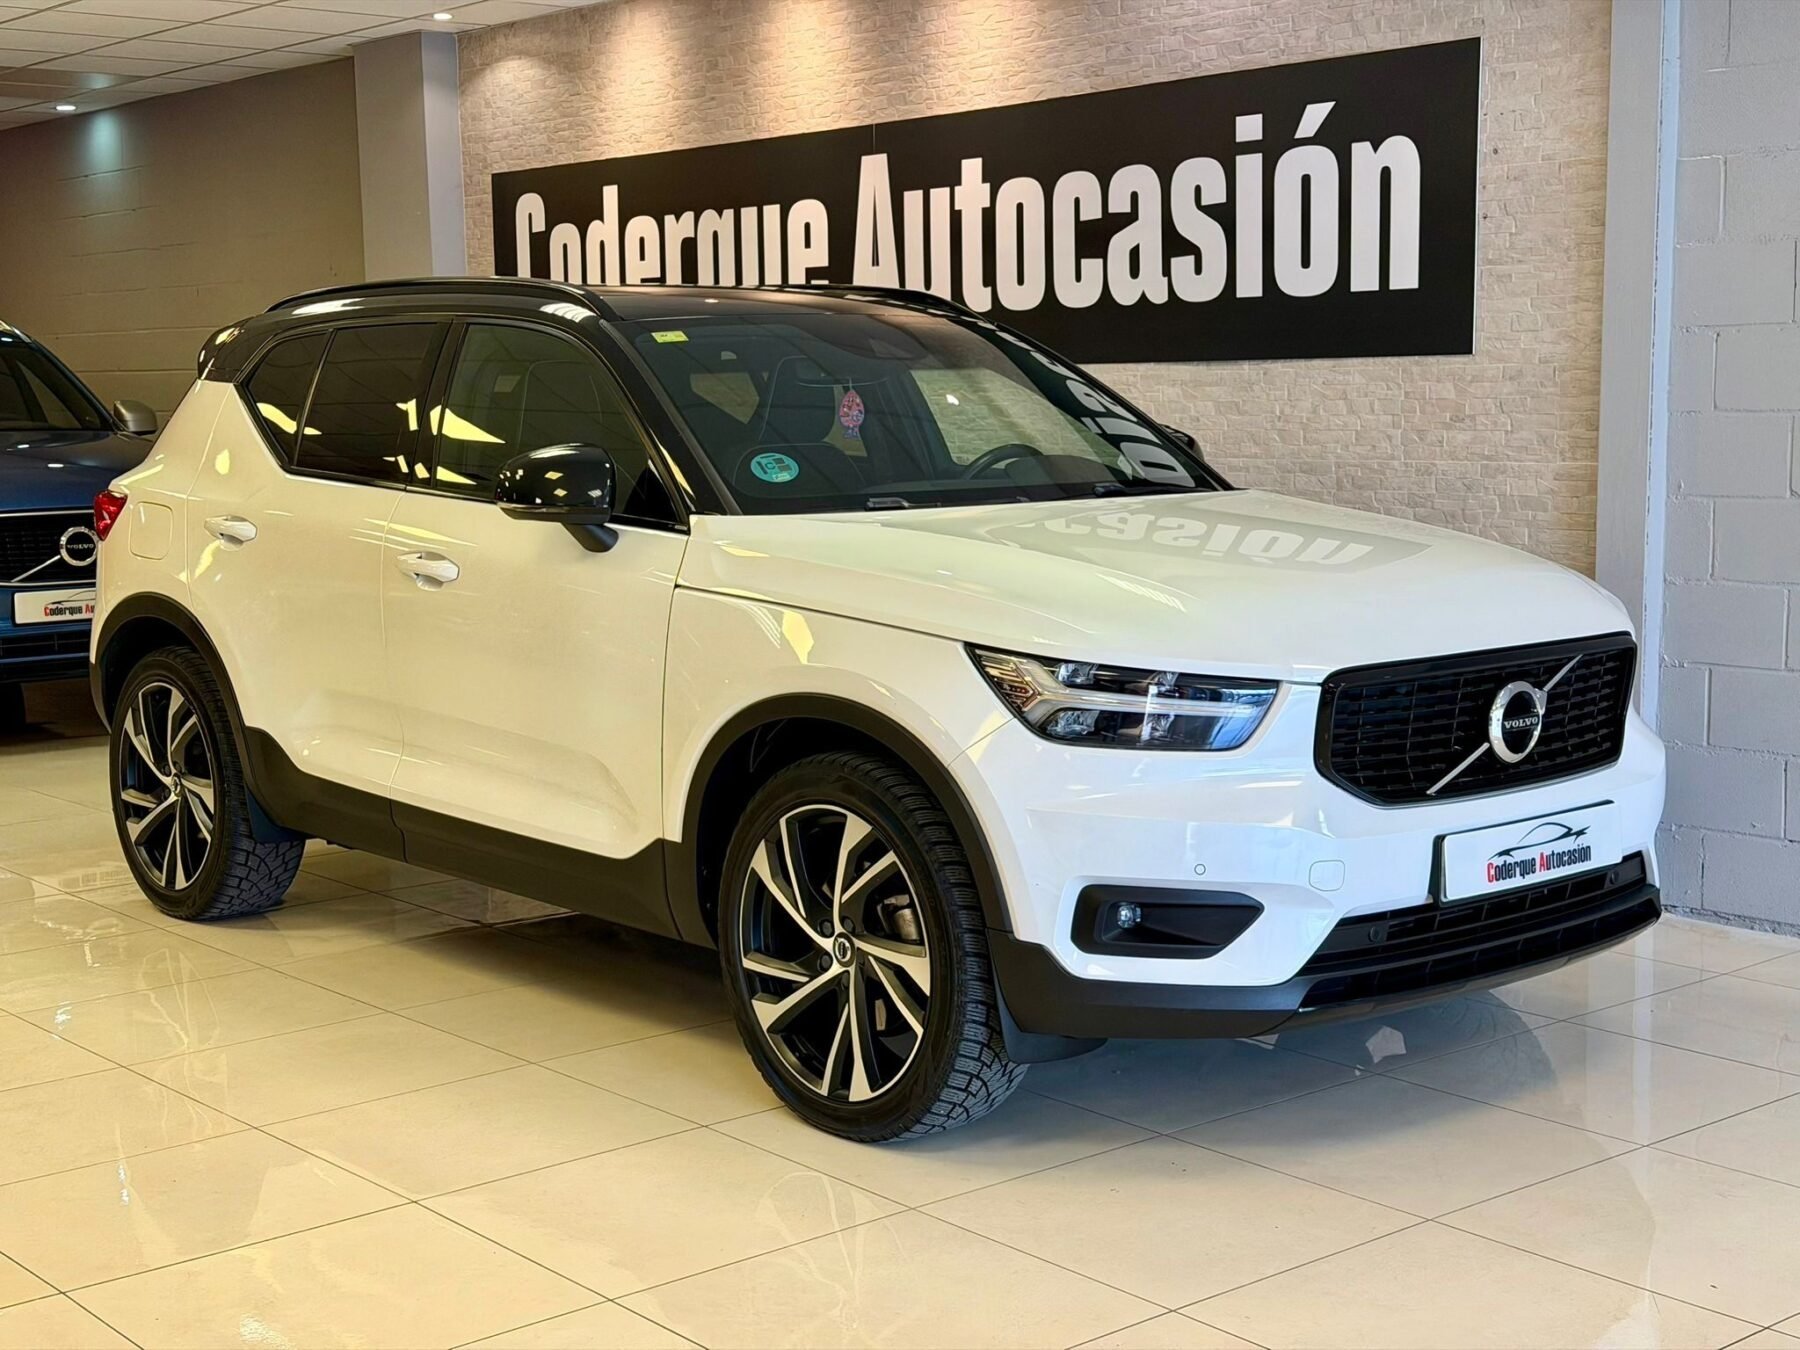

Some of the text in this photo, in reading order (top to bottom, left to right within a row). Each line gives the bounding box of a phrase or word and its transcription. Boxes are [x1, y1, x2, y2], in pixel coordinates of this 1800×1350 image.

[852, 101, 1421, 312] Autocasión
[44, 605, 83, 616] Coderque
[1503, 716, 1538, 729] VOLVO
[1487, 843, 1591, 883] Coderque Autocasión
